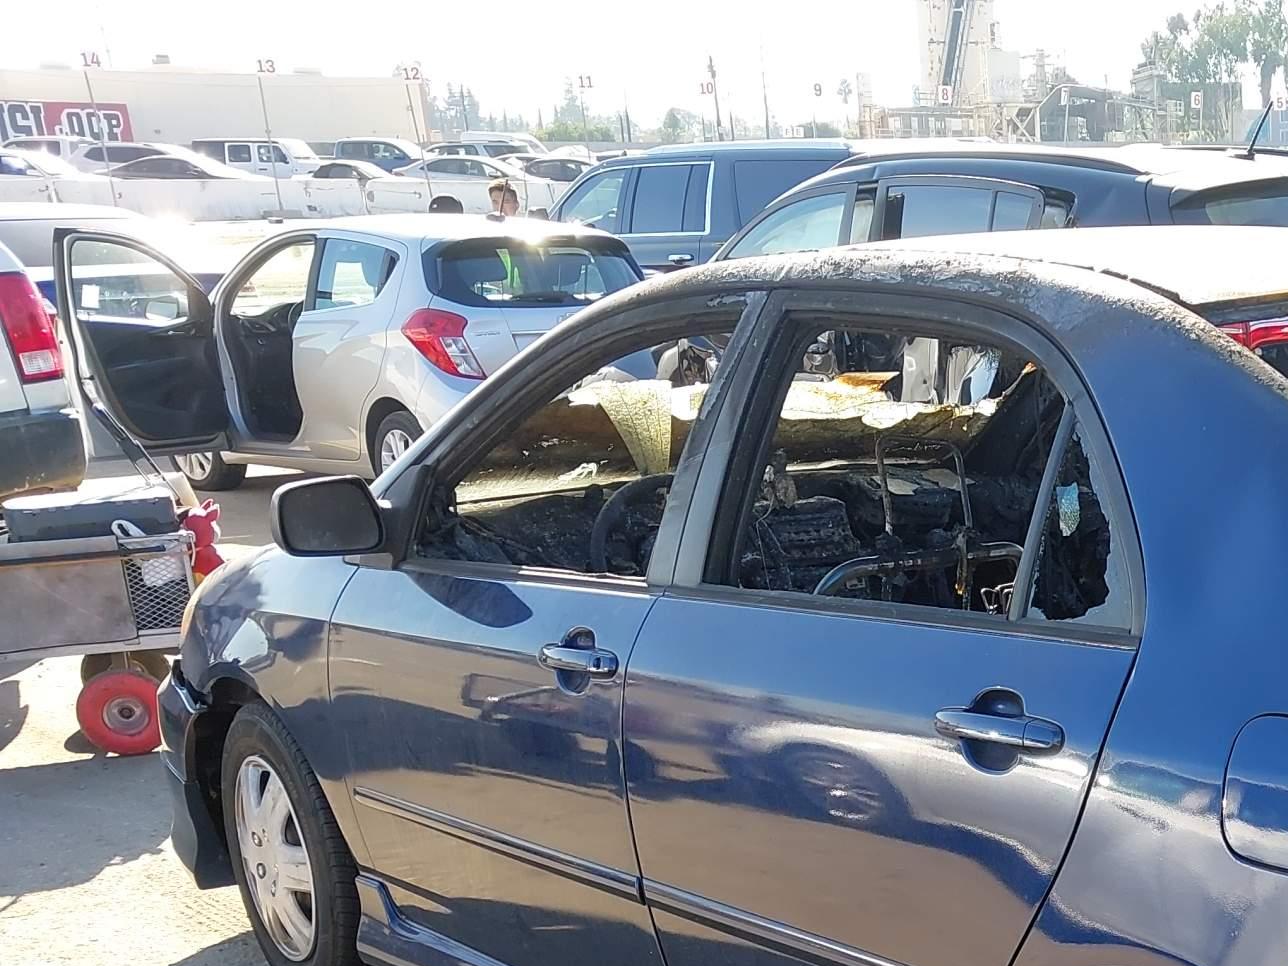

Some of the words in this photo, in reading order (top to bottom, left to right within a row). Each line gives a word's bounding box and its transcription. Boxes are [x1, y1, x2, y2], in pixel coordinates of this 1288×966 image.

[80, 52, 101, 67] 14
[256, 59, 276, 73] 13
[402, 67, 420, 80] 12
[578, 75, 594, 89] 11
[700, 82, 713, 95] 10
[813, 83, 823, 97] 9
[941, 87, 949, 101] 8
[1193, 93, 1200, 107] 6
[1276, 96, 1284, 109] 5
